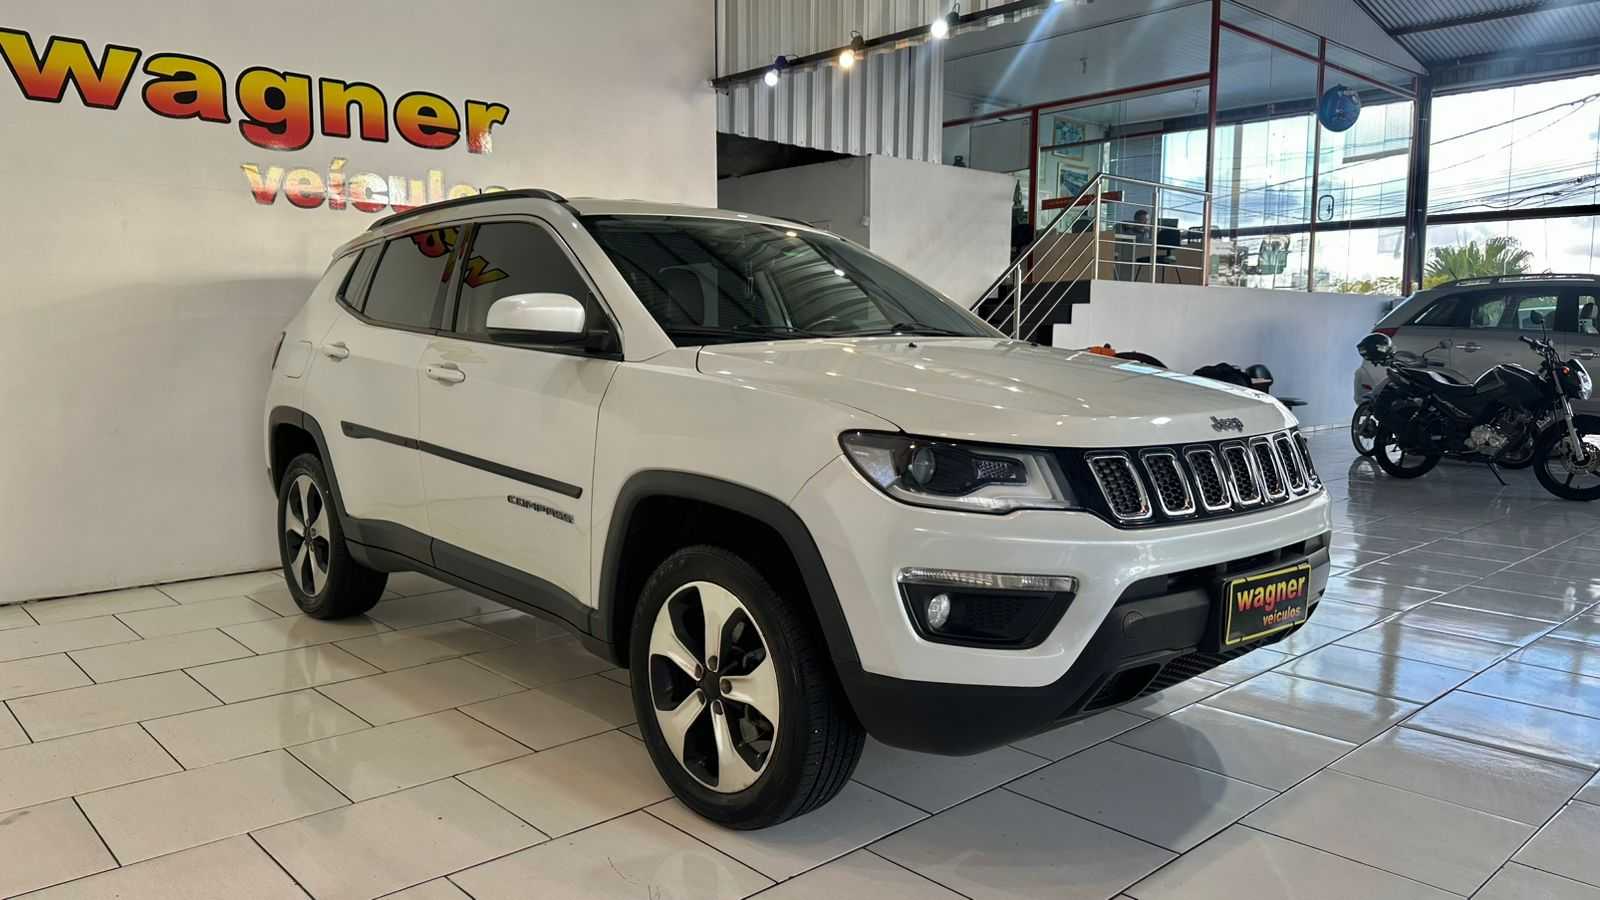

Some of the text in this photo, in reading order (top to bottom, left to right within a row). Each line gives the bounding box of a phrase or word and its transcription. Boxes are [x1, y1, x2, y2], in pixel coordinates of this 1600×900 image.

[0, 27, 509, 154] wagner
[240, 157, 508, 213] veícul
[1237, 577, 1306, 612] wagner
